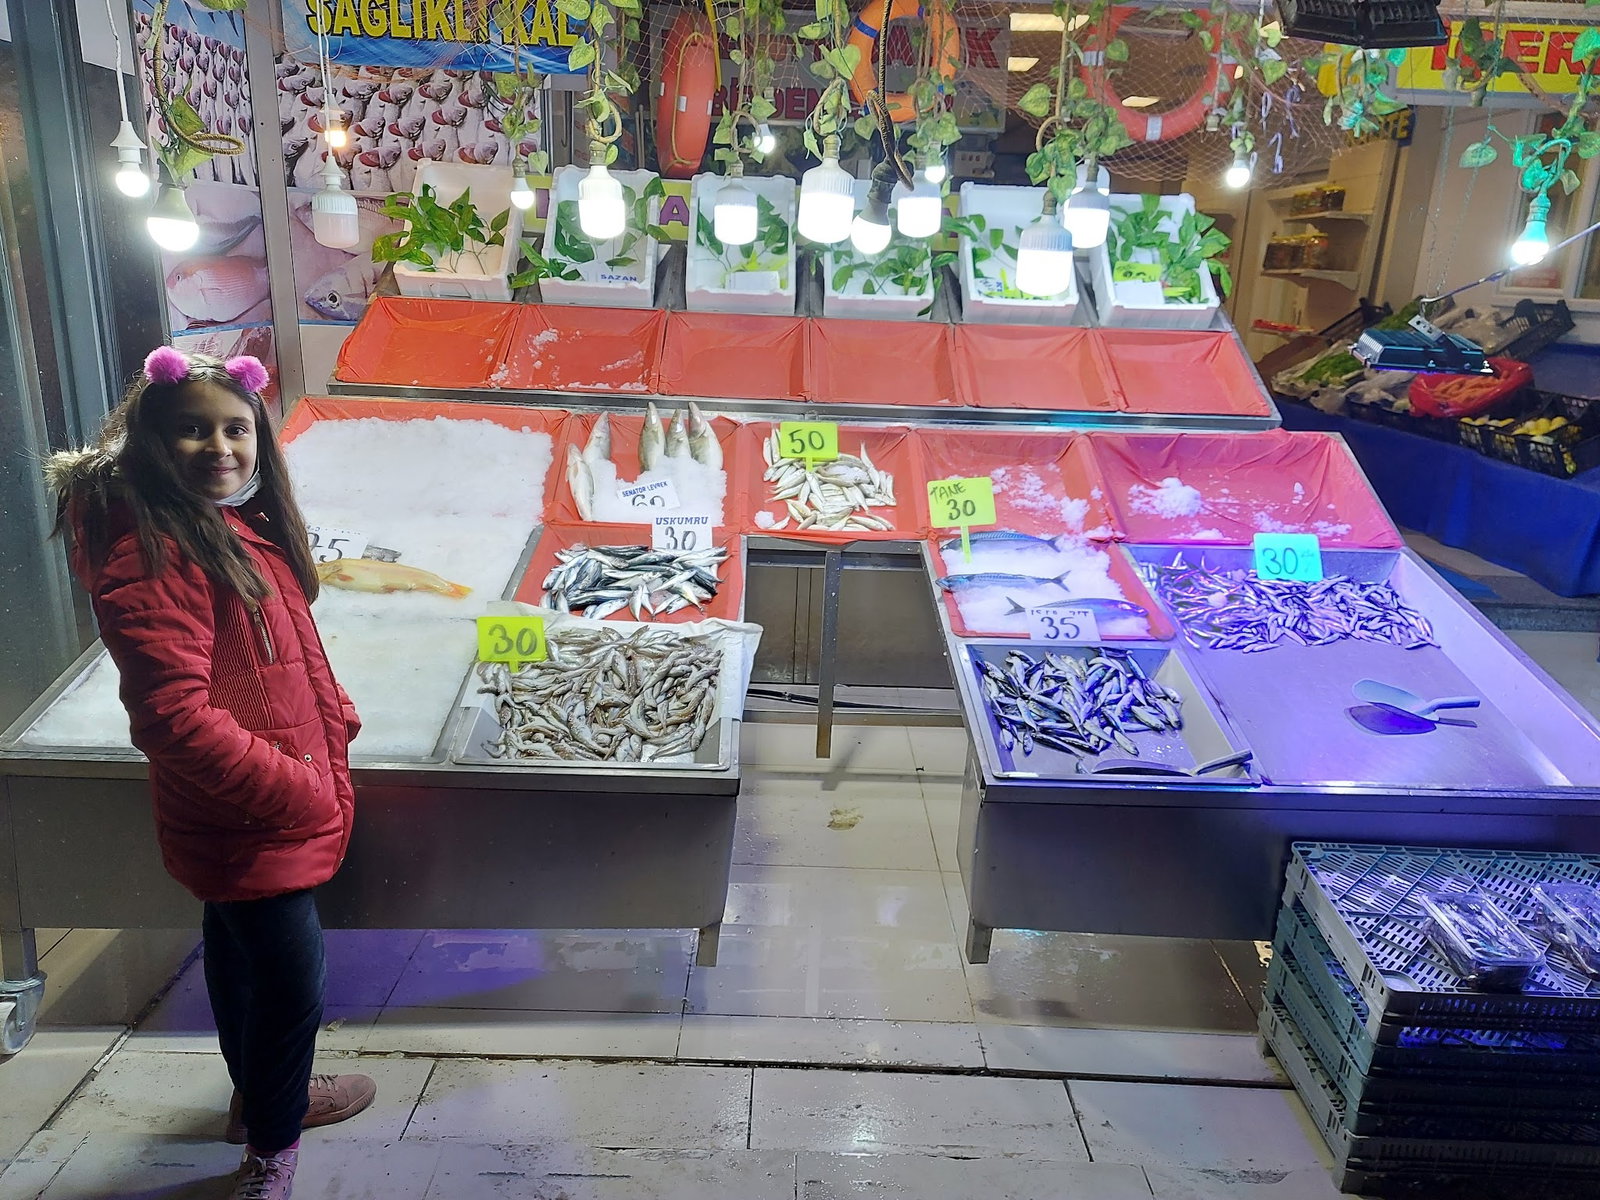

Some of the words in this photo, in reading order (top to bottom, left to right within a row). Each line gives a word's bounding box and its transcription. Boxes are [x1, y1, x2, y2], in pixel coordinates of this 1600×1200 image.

[600, 273, 637, 282] SAZAN
[788, 429, 825, 454] 50
[622, 486, 647, 498] SENATOR
[656, 516, 709, 526] USKUMRU
[946, 498, 977, 521] 30
[664, 526, 697, 551] 30
[1262, 547, 1299, 575] 30
[488, 623, 538, 657] 30
[1040, 616, 1080, 640] 35
